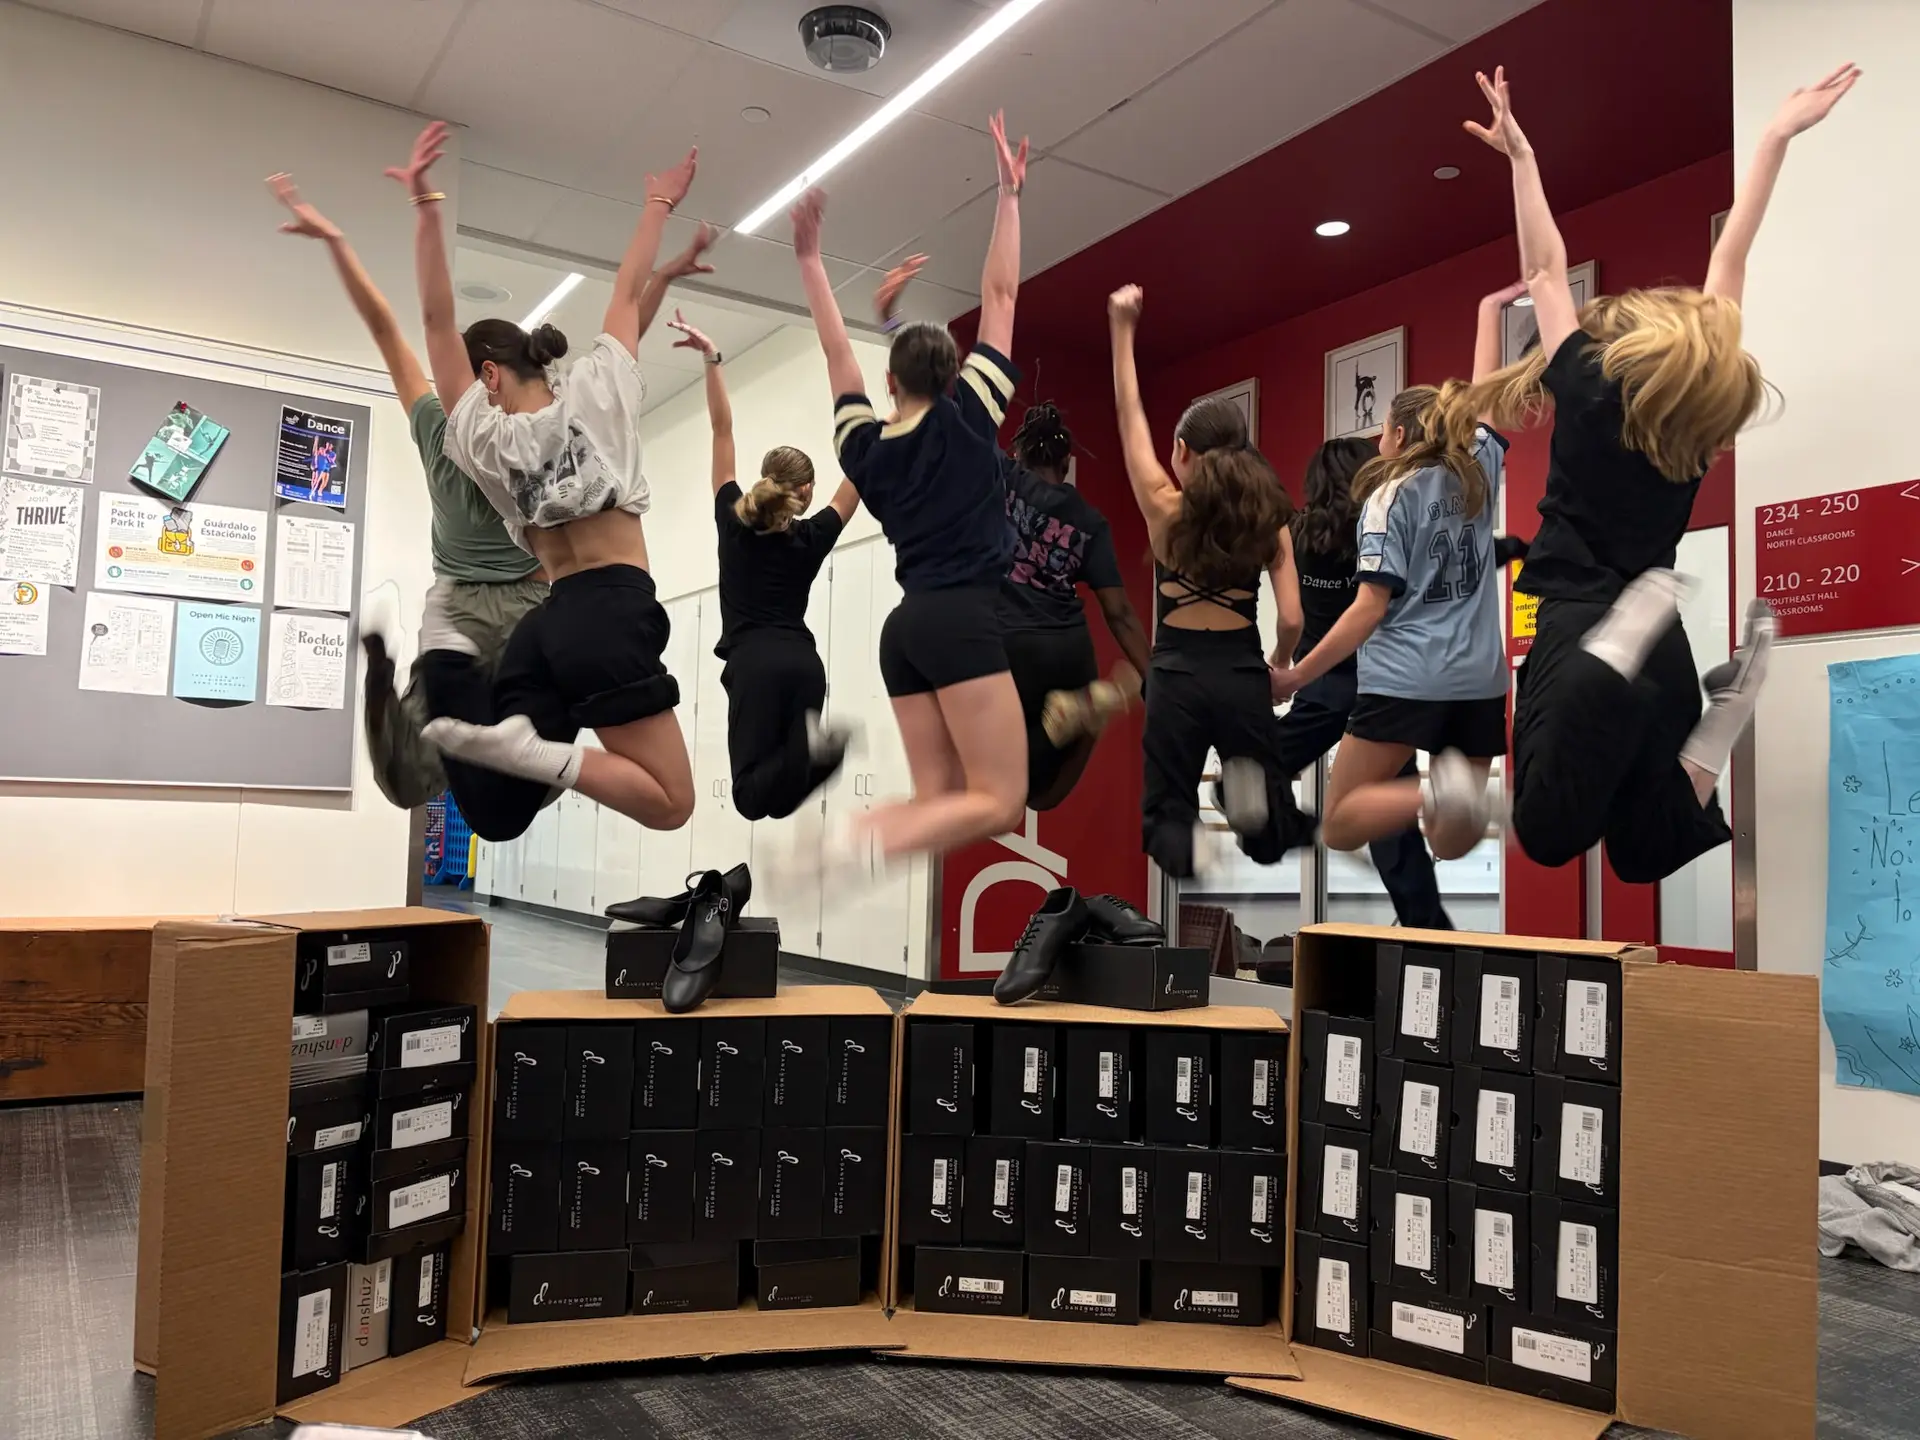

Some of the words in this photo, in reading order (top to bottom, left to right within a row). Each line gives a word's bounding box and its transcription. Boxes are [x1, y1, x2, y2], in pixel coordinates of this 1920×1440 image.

[307, 418, 345, 434] Dance
[111, 508, 135, 519] Pack
[137, 511, 145, 519] It
[1428, 495, 1467, 521] GLA
[1762, 503, 1800, 526] 234
[1820, 493, 1859, 516] 250
[111, 517, 135, 528] Park
[137, 520, 145, 528] It
[203, 519, 249, 531] Guárdalo
[201, 527, 256, 541] Estaciónalo
[1766, 528, 1794, 539] DANCE
[1766, 539, 1795, 550] NORTH
[1797, 530, 1856, 545] CLASSROOMS
[1302, 574, 1342, 589] Dance
[1763, 572, 1800, 593] 210
[1820, 564, 1860, 586] 220
[1767, 593, 1816, 606] SOUTHEAST
[1817, 591, 1839, 600] HALL
[1515, 603, 1537, 611] enteri
[1772, 604, 1824, 617] LASSROOMS
[189, 611, 214, 620] Open
[215, 613, 230, 621] Mic
[232, 615, 256, 624] Night
[298, 630, 344, 646] Rocket
[313, 645, 343, 658] Club
